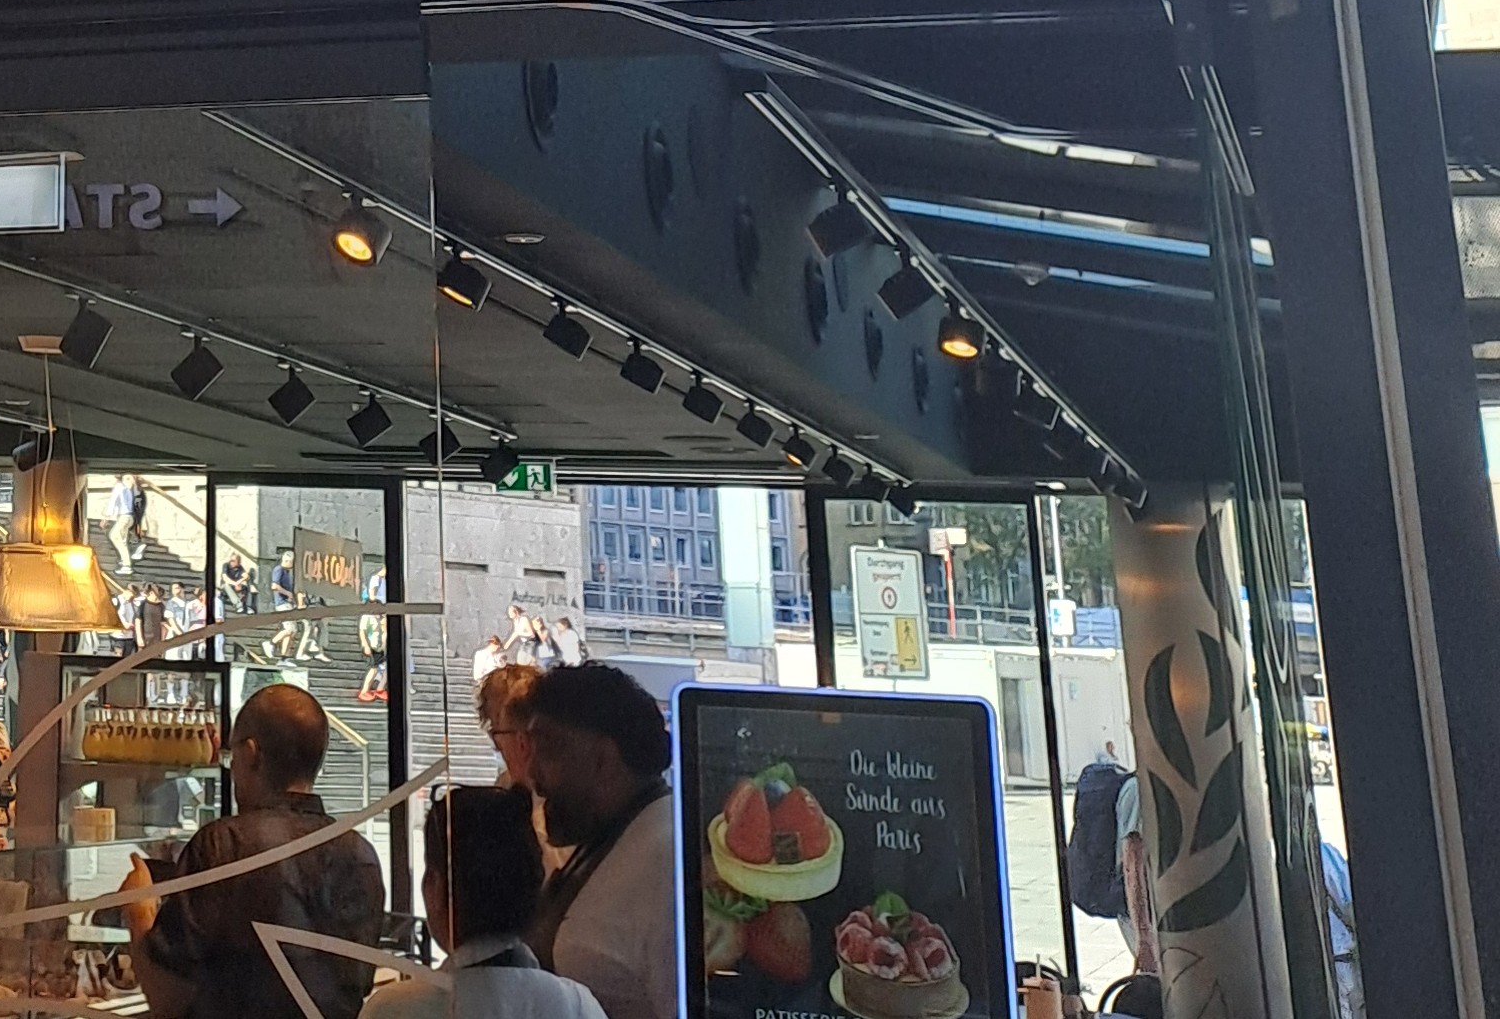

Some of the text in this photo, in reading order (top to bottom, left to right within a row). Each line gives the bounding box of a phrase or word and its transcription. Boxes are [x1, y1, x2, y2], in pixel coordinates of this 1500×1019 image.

[850, 748, 938, 780] Die kleine
[911, 797, 946, 820] aus
[876, 820, 922, 854] Paris
